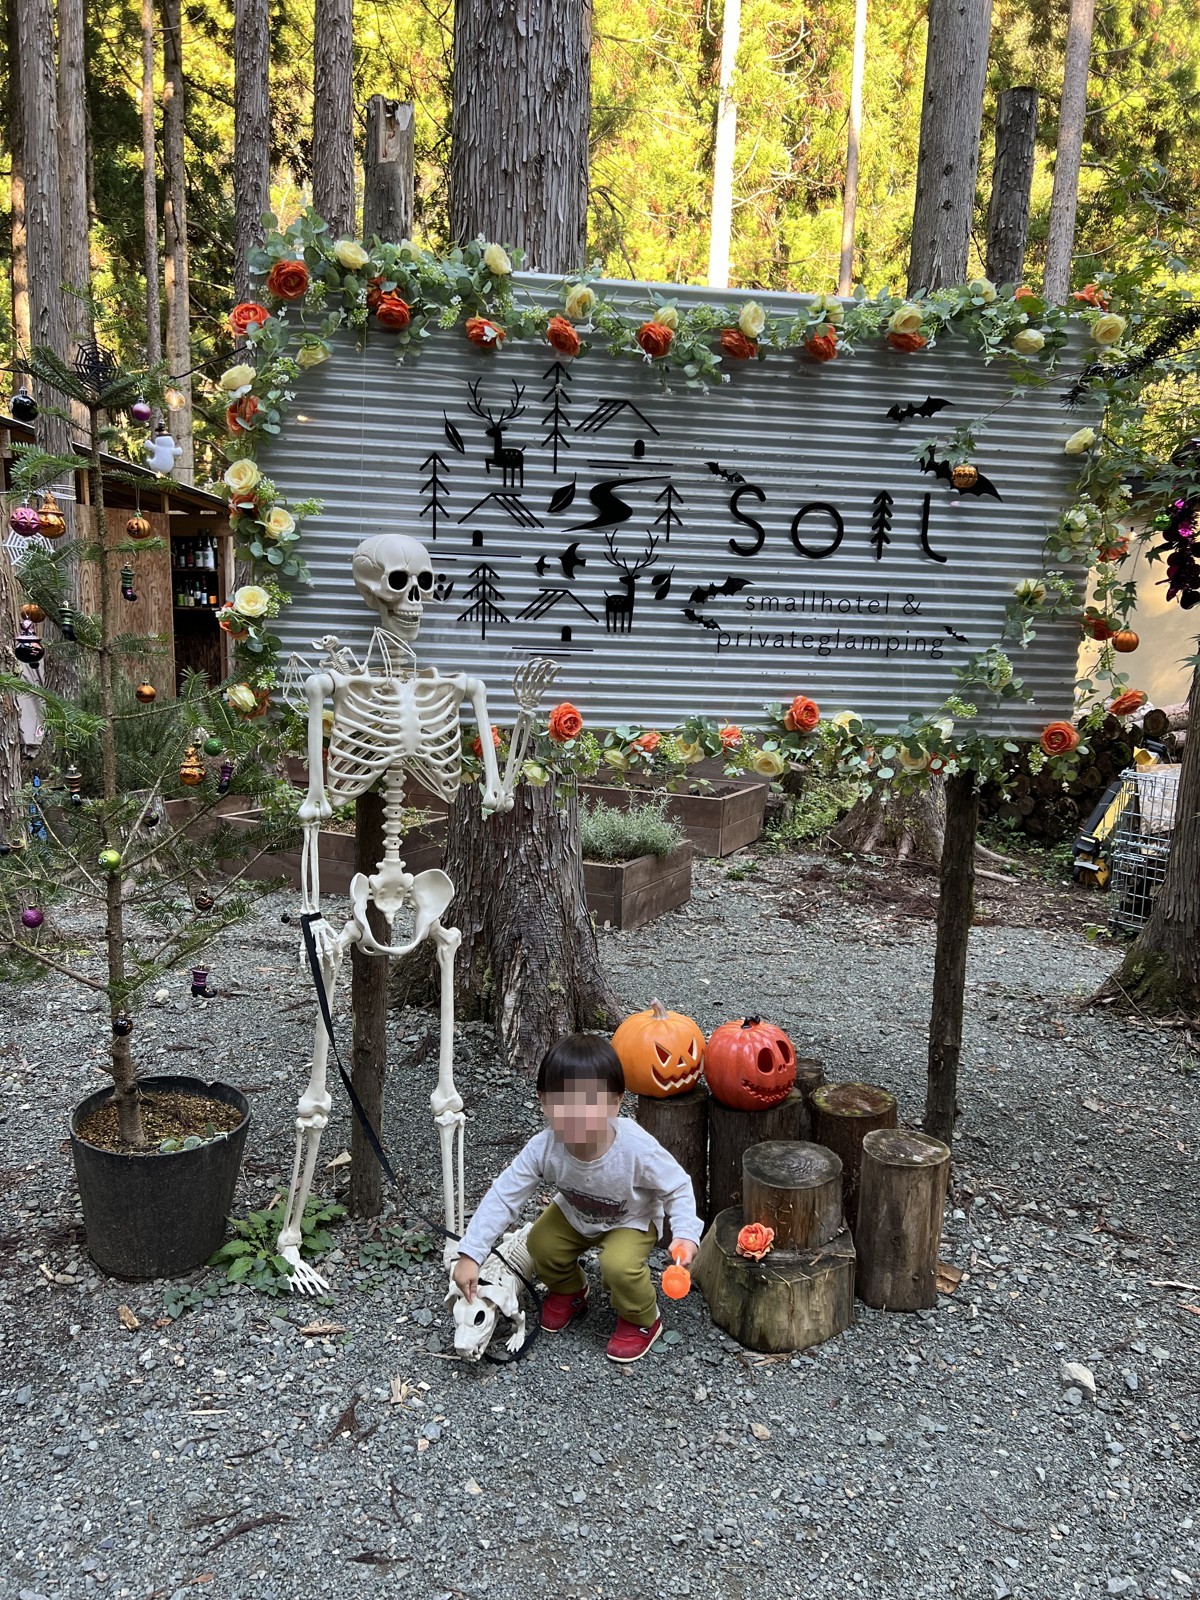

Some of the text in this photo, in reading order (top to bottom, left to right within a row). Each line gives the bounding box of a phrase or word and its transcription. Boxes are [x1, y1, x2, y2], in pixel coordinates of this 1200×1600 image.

[745, 590, 923, 616] smallhotel &
[716, 625, 946, 660] privateglamping
